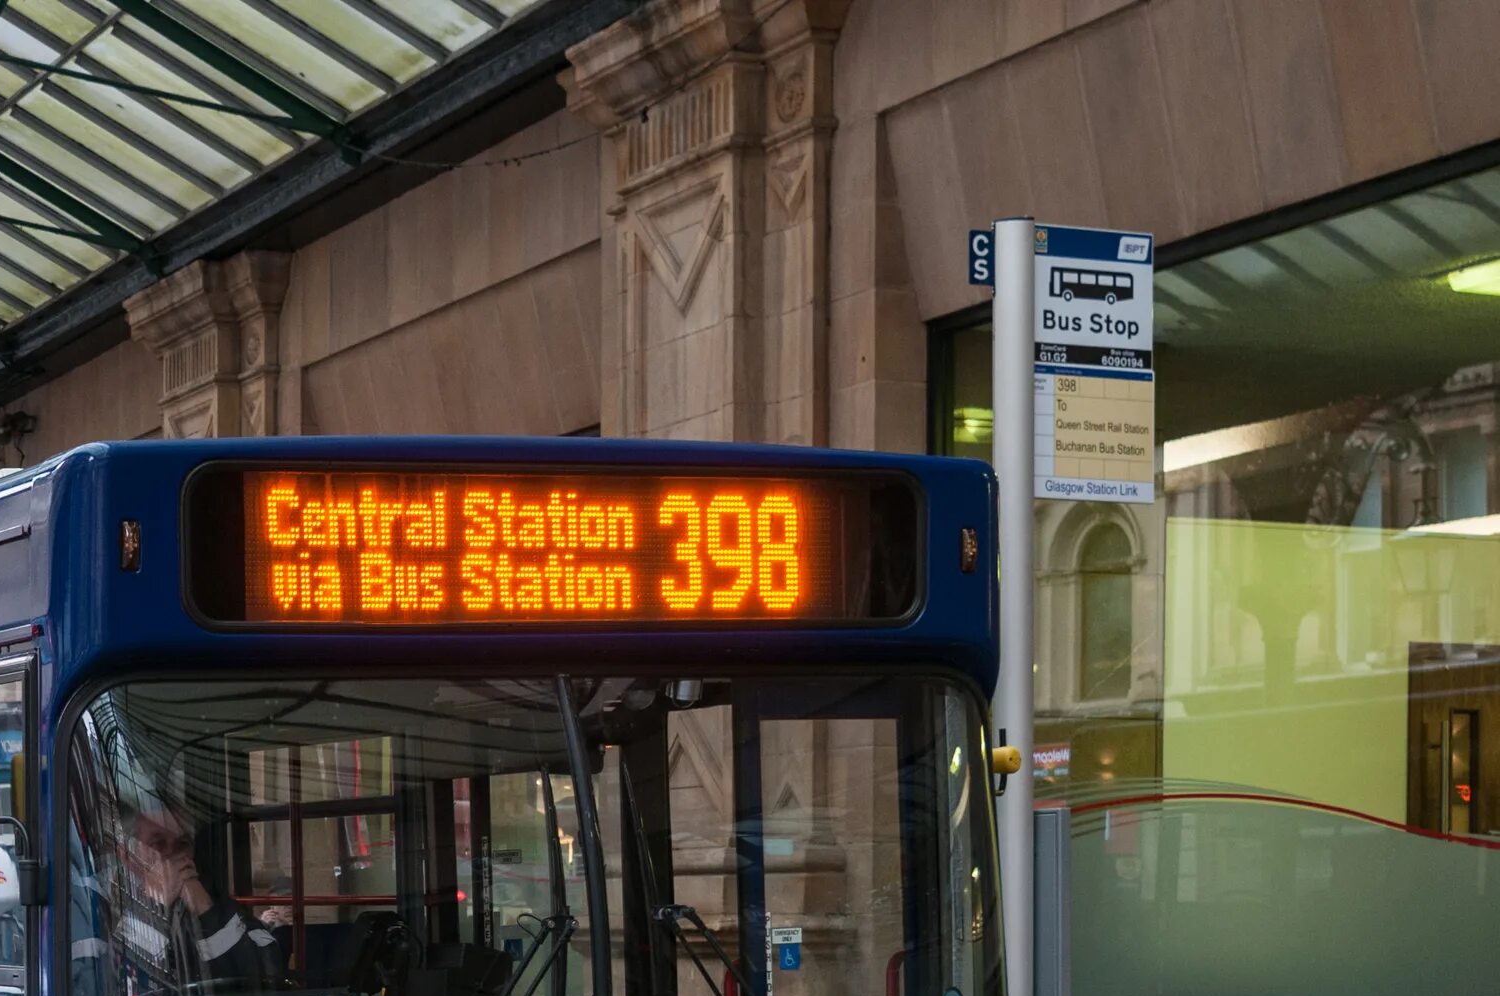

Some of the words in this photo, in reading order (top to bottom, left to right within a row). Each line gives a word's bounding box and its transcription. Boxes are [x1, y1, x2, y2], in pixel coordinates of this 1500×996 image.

[1043, 309, 1082, 332] Bus
[1089, 313, 1139, 339] Stop
[1101, 356, 1143, 368] 6090194
[1058, 378, 1077, 392] 398
[1057, 399, 1067, 411] To
[1056, 419, 1081, 430] Queen
[1083, 420, 1106, 432] Street
[1108, 422, 1122, 433] Rail
[1124, 423, 1149, 434] Station
[1056, 440, 1096, 452] Buchanan
[1099, 442, 1115, 454] Bus
[1117, 443, 1145, 456] Station
[1045, 480, 1084, 495] Glasgow
[1086, 482, 1117, 495] Station
[1120, 484, 1138, 496] Link
[267, 489, 446, 547] Central
[464, 491, 634, 548] Station
[659, 495, 798, 609] 398
[274, 552, 341, 609] via
[360, 553, 443, 609] Bus
[462, 554, 631, 609] Station
